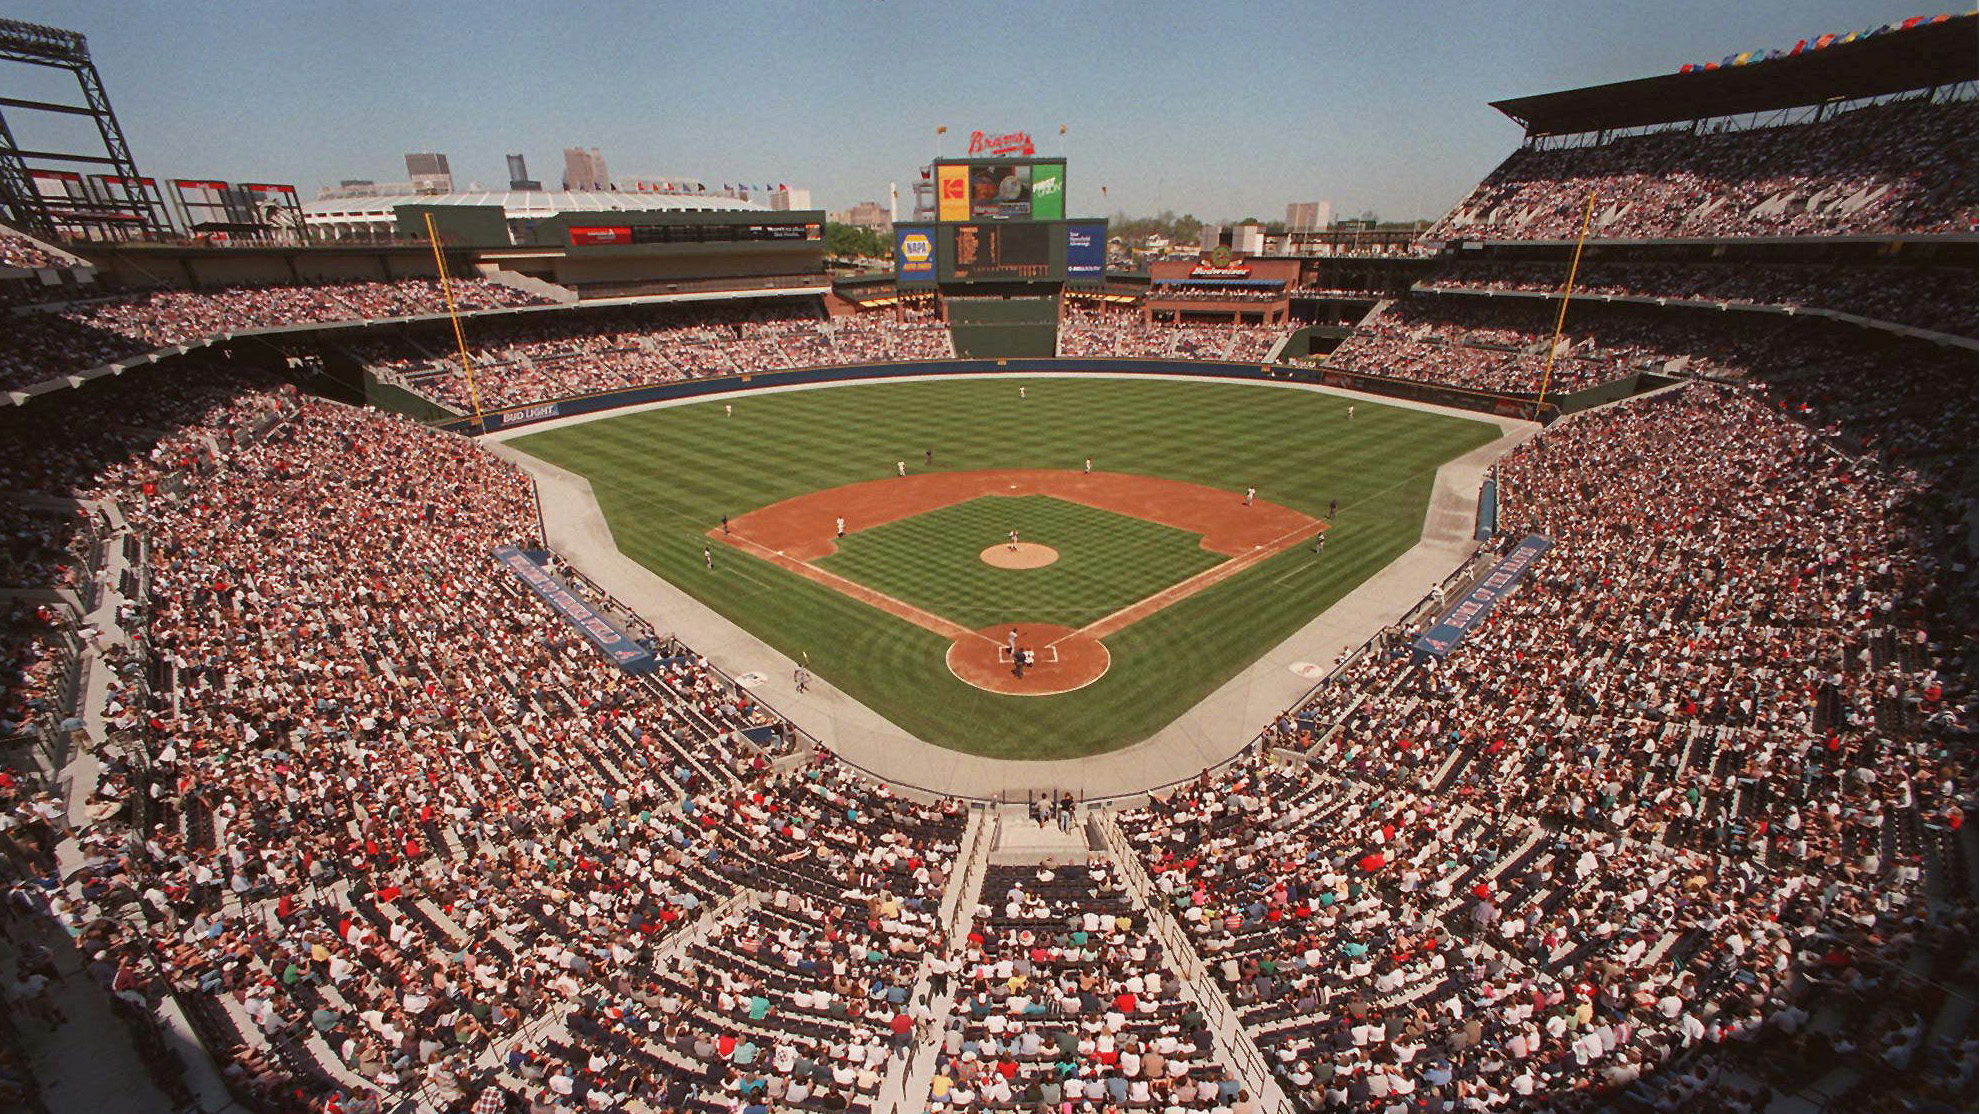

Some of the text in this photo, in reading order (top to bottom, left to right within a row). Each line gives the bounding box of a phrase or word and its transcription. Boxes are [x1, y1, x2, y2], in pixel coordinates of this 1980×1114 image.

[968, 130, 1024, 155] Braves
[907, 242, 927, 254] NAPA
[1192, 267, 1251, 275] Budweiser
[503, 405, 554, 423] BUD LIGHT
